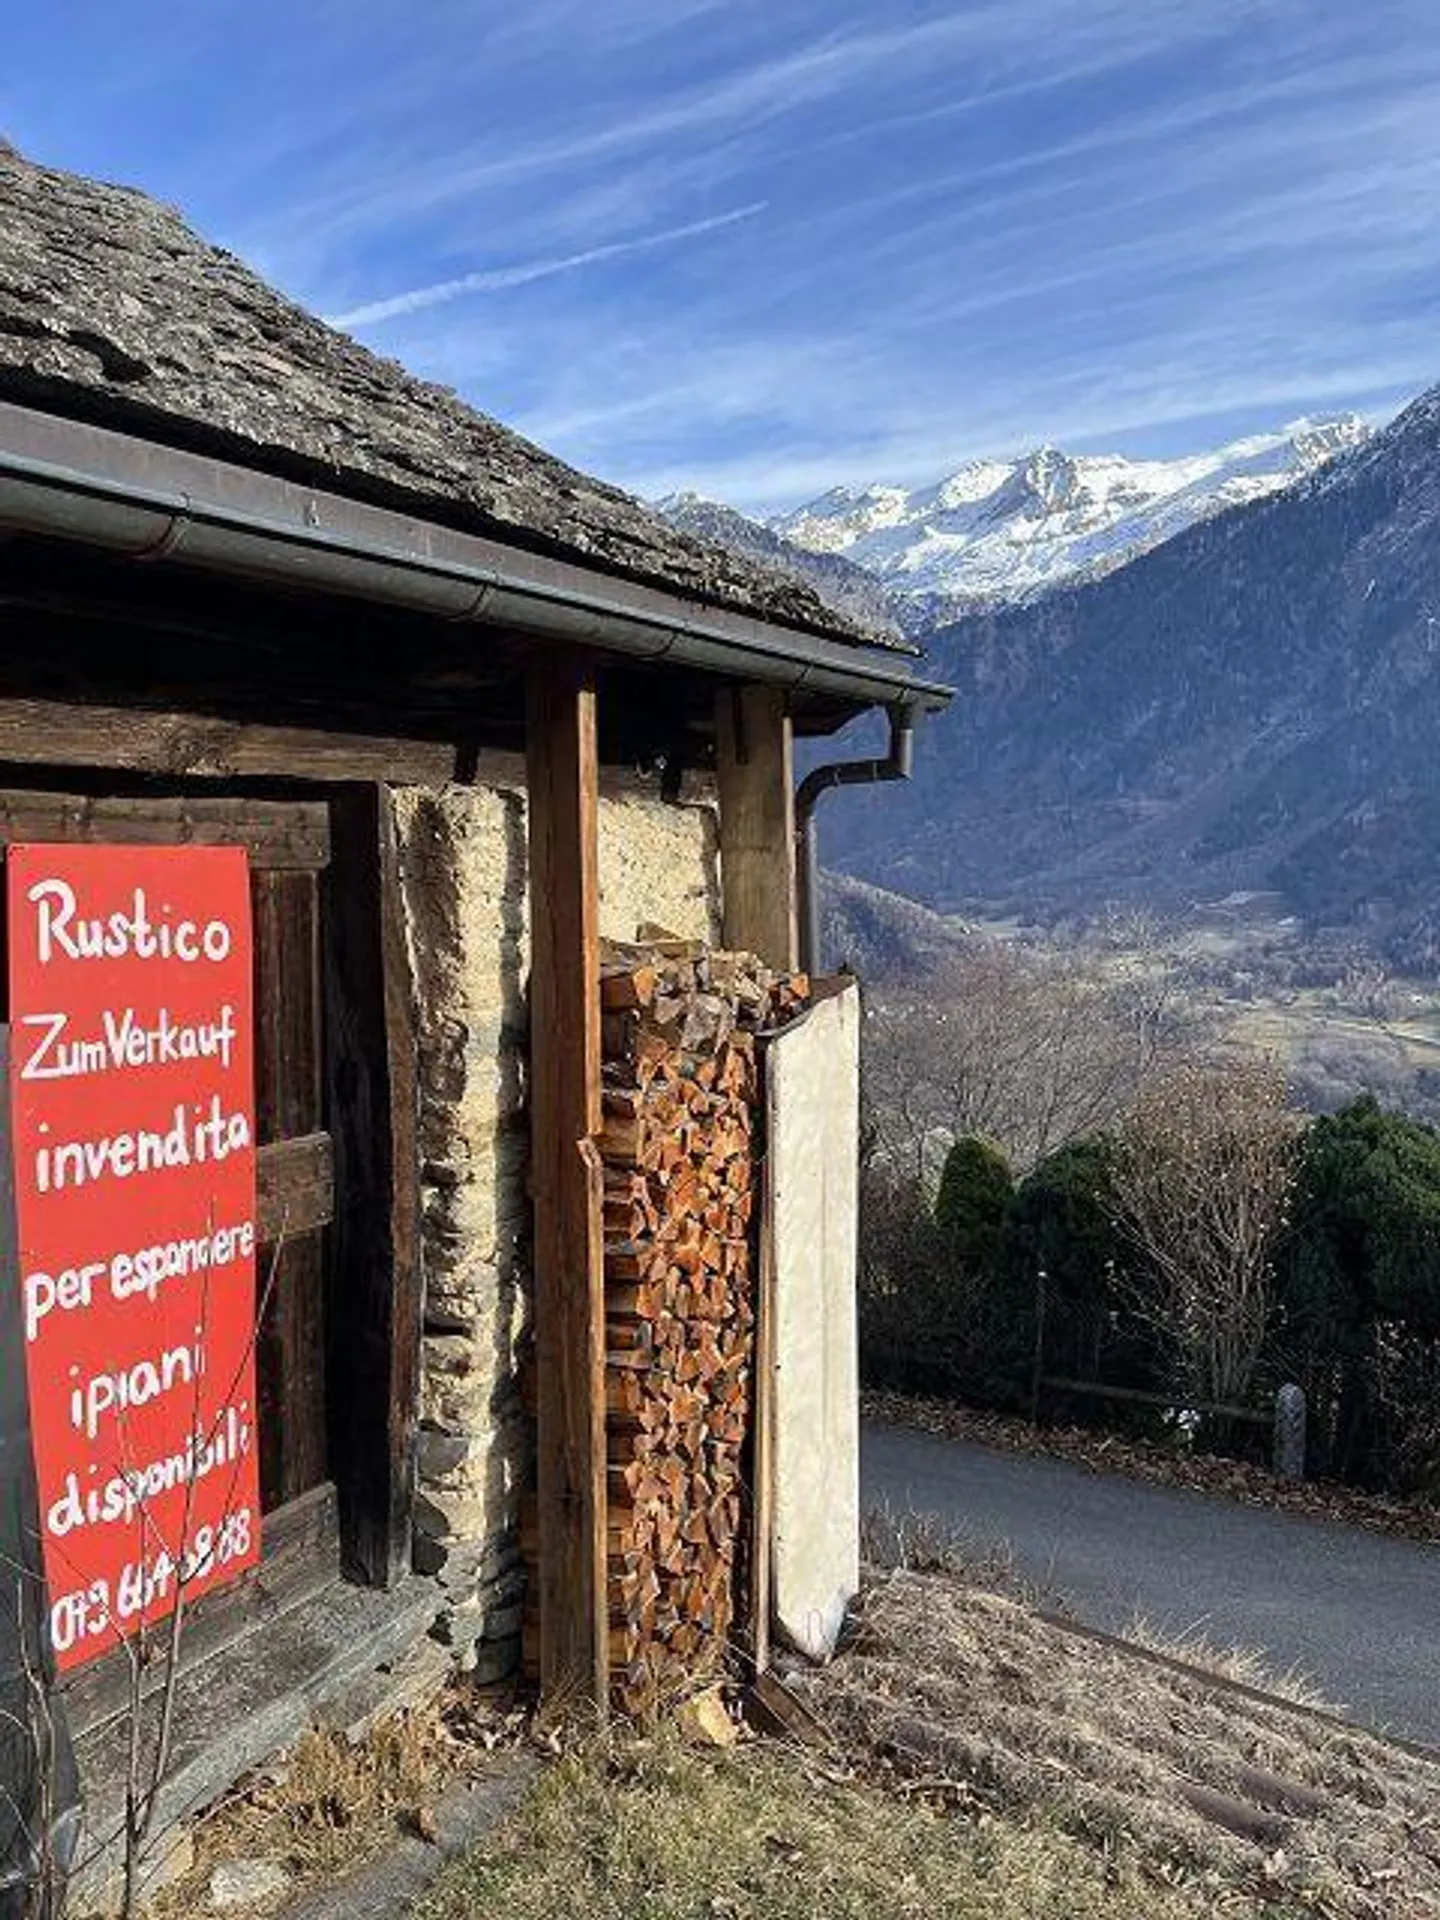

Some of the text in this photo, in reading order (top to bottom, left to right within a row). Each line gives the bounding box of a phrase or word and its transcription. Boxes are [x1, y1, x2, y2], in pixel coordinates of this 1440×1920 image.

[27, 878, 231, 962] Rustico
[24, 1263, 106, 1341] per
[48, 1401, 249, 1537] disponibili
